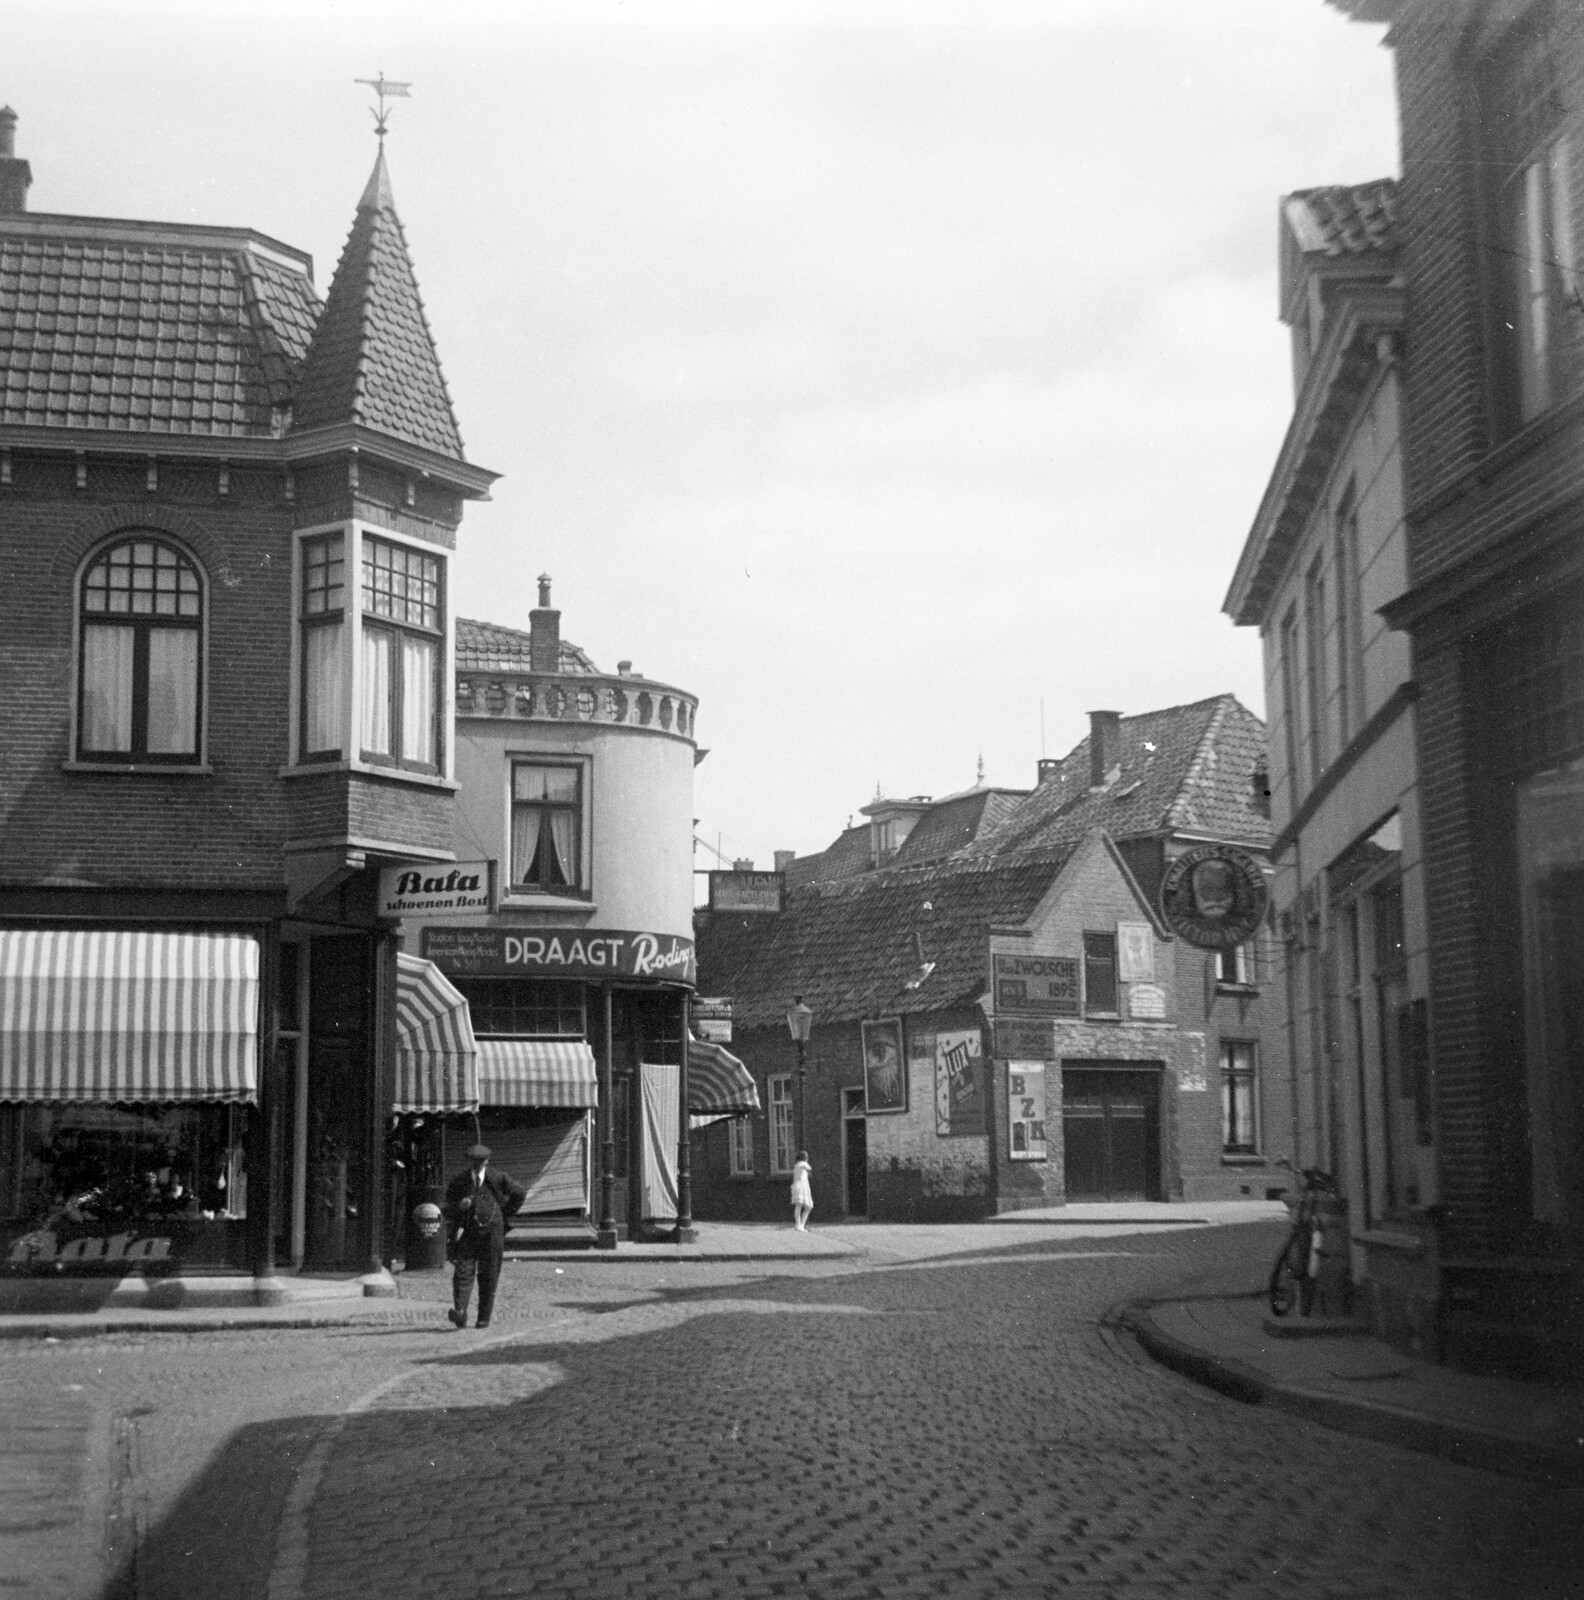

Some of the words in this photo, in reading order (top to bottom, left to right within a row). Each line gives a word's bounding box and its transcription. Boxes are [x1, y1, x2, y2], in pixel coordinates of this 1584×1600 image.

[394, 869, 481, 896] Bata
[386, 898, 454, 911] schoenen
[456, 895, 488, 908] Best
[504, 937, 625, 967] DRAAGT
[1014, 960, 1077, 979] ZWOLSCHE
[1048, 981, 1077, 998] 1895
[946, 1044, 969, 1076] LUX
